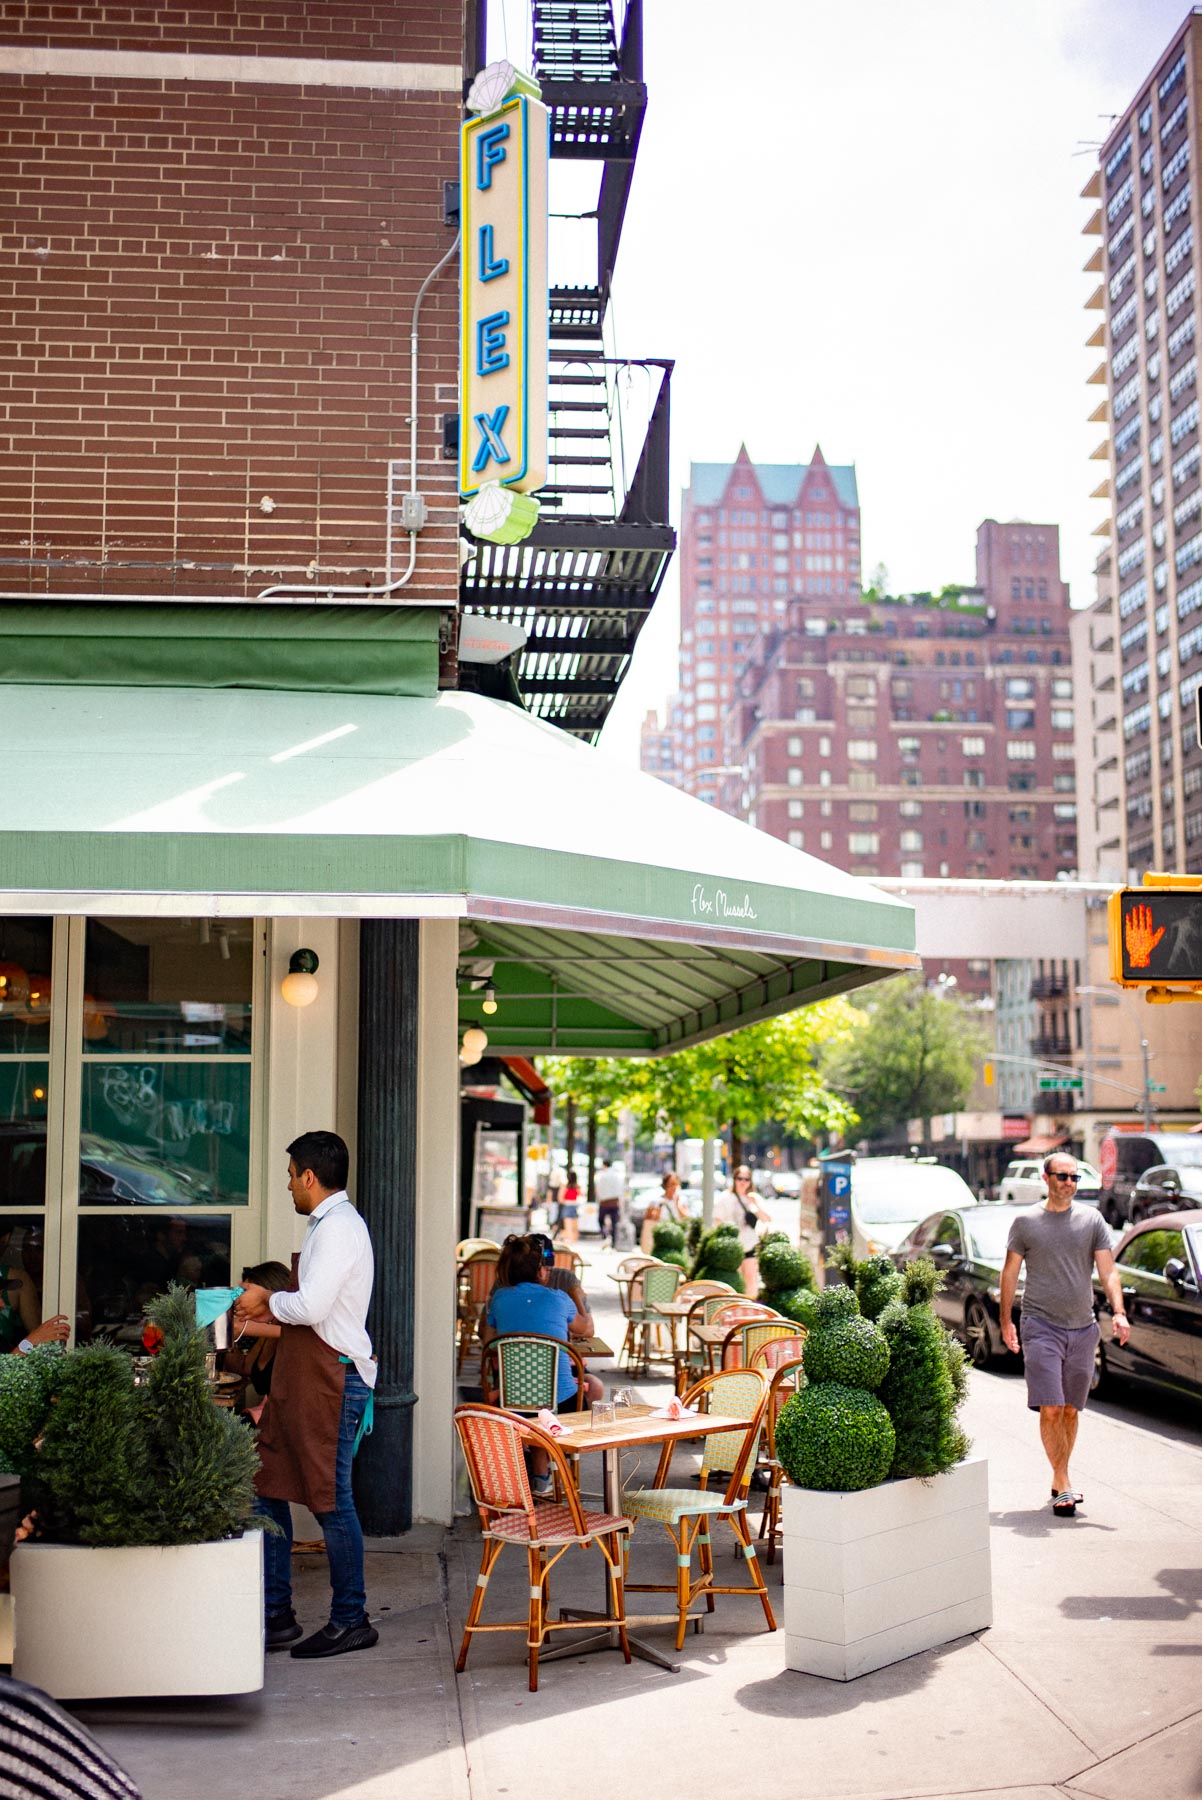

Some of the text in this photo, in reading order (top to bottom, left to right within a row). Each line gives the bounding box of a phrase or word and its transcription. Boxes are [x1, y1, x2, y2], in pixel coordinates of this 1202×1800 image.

[472, 122, 510, 473] FLEX
[715, 889, 758, 919] Mussels
[834, 1176, 848, 1195] P
